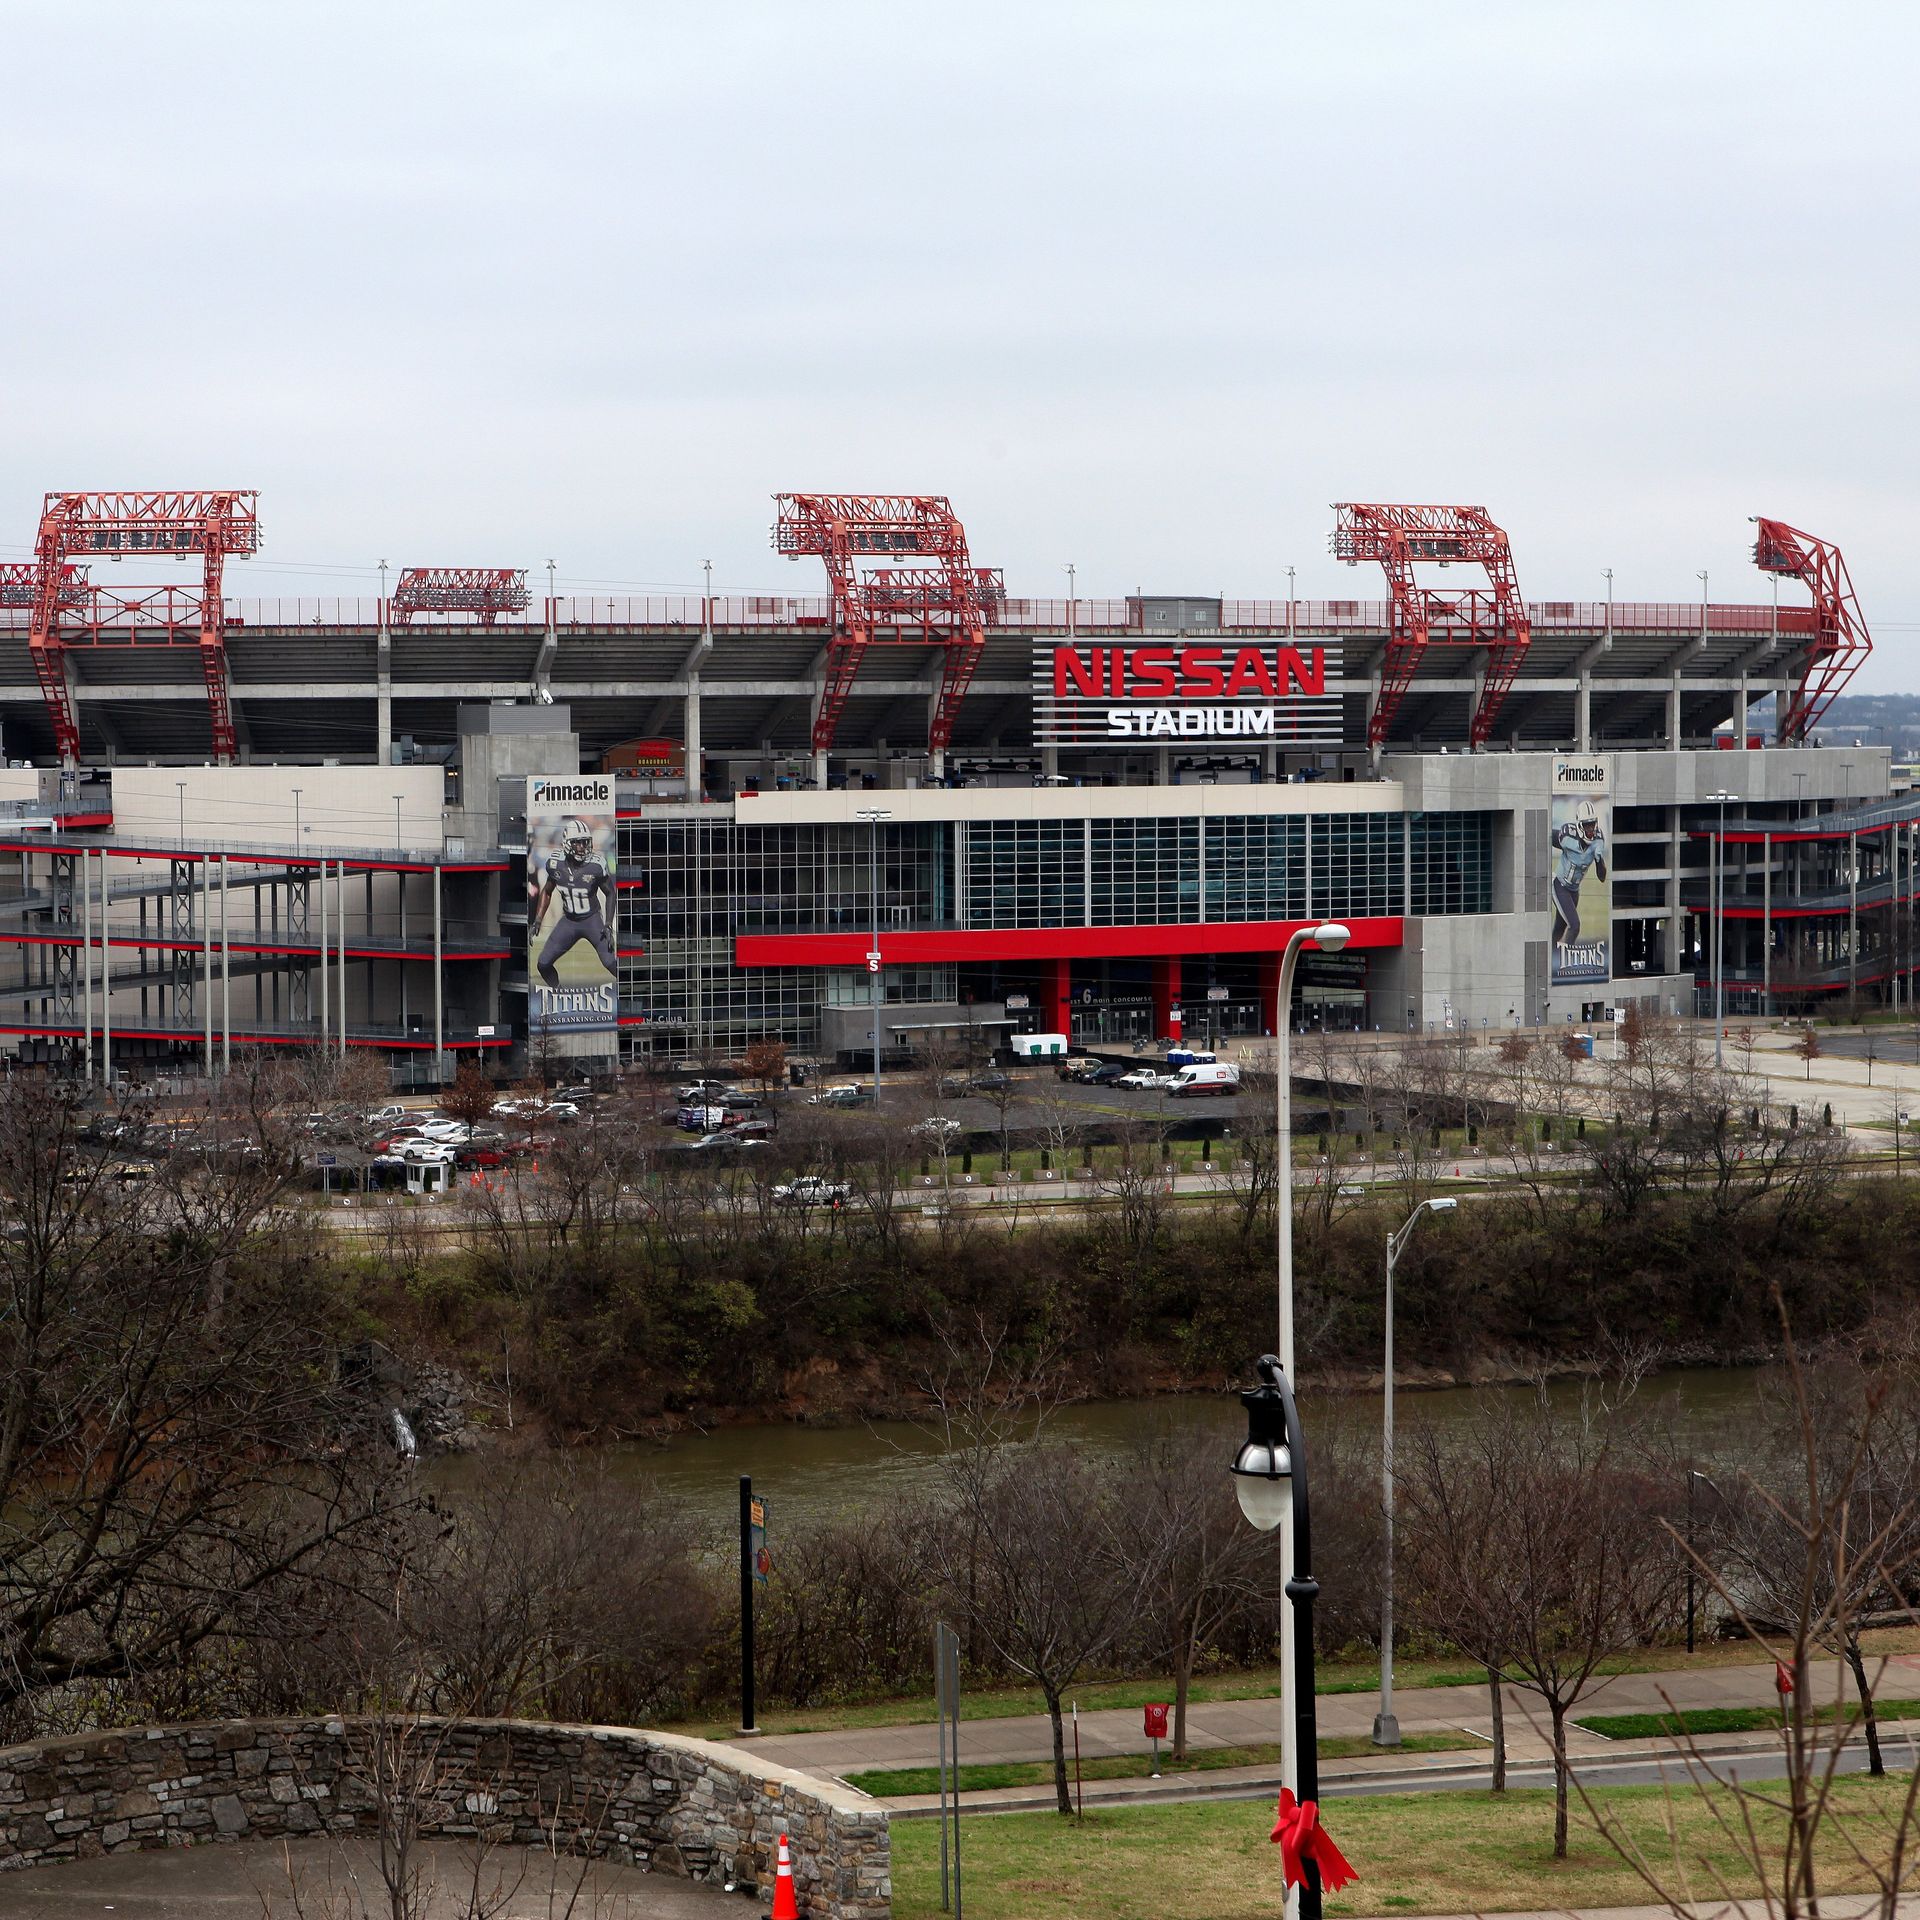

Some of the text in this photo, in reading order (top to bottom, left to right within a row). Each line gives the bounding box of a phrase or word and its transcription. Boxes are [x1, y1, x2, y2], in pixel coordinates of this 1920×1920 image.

[1053, 648, 1325, 698] NISSAN
[1107, 708, 1275, 736] STADIUM
[1558, 764, 1604, 782] Pinnacle
[534, 781, 609, 801] Pinnacle
[1557, 941, 1605, 969] TITANS
[869, 960, 879, 971] S
[535, 982, 613, 1016] TITANS
[1082, 988, 1092, 1004] 6
[1113, 995, 1153, 1003] concourse
[537, 1015, 613, 1025] TIANSBANKING.COM
